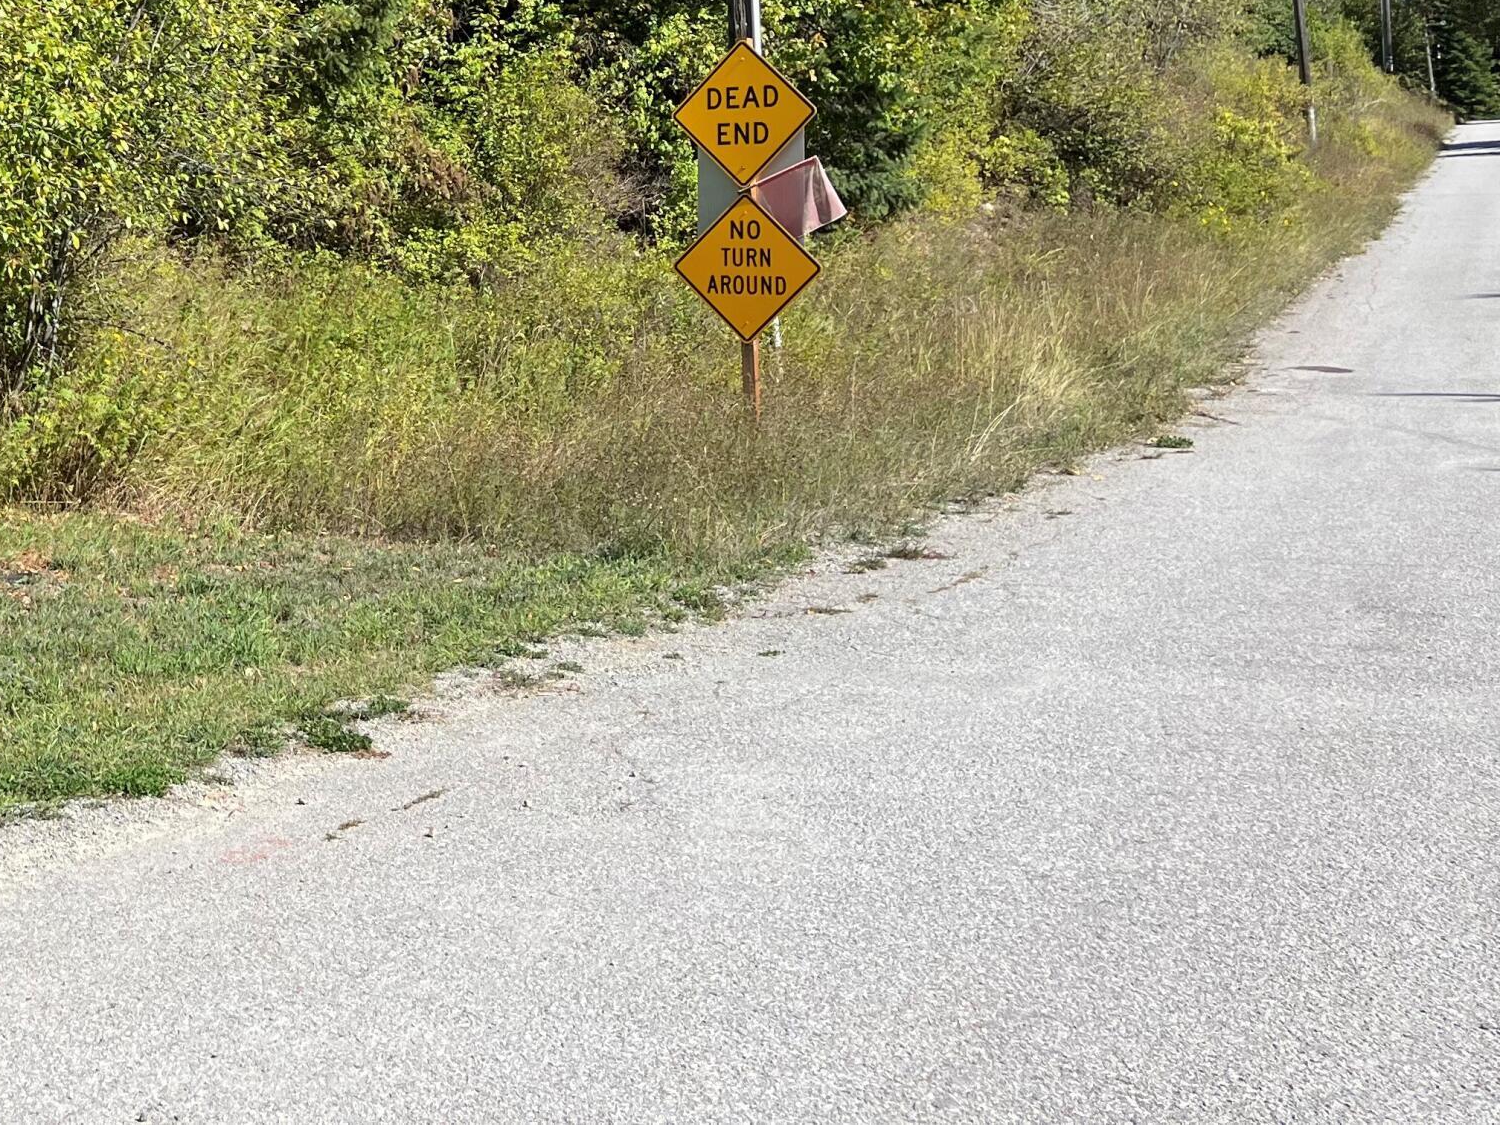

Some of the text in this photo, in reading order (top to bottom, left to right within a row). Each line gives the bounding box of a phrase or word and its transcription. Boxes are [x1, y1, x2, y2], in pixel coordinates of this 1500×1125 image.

[706, 85, 779, 110] DEAD
[717, 122, 769, 145] END
[730, 220, 760, 240] NO
[721, 248, 771, 267] TURN
[707, 275, 787, 295] AROUND
